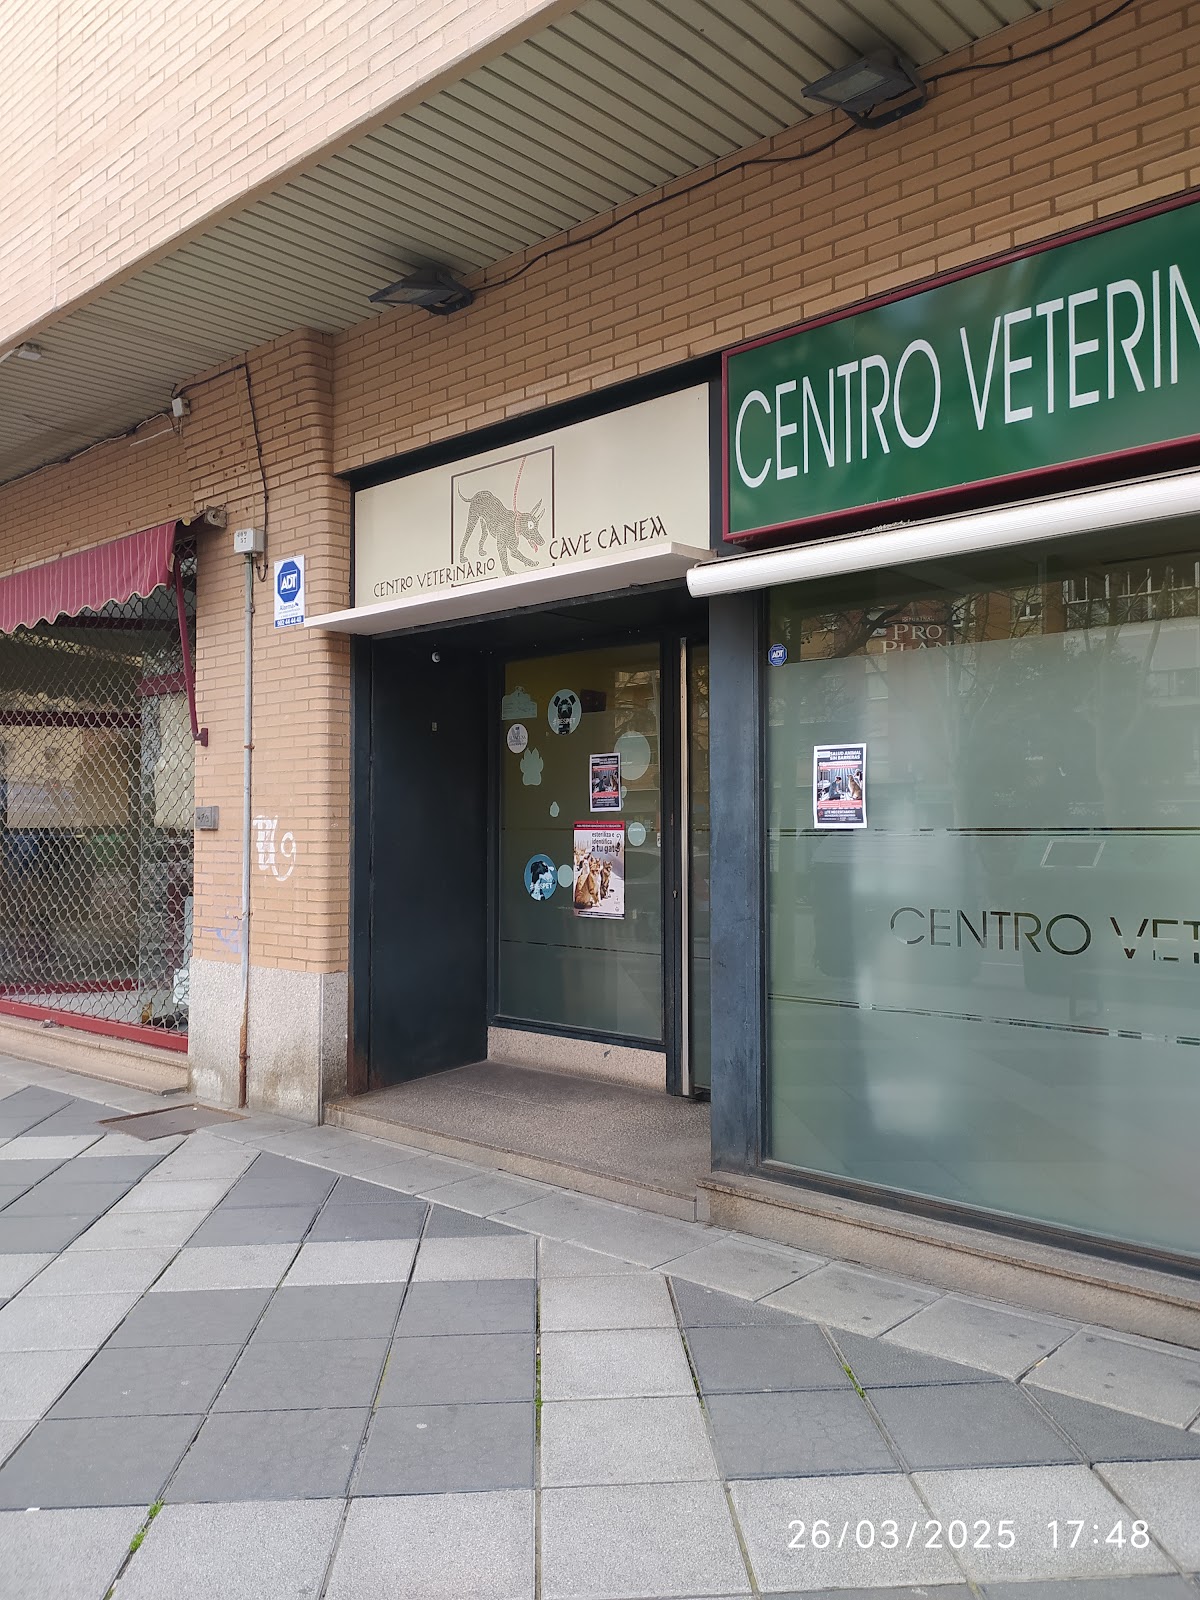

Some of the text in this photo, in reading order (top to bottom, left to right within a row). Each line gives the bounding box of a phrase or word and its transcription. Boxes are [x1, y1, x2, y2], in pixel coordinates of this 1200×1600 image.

[735, 264, 1200, 488] CENTRO VETERIN
[549, 515, 668, 560] CAVE CANEM
[280, 574, 297, 591] ADT
[373, 558, 496, 598] CENTRO VETERINARIO
[892, 623, 943, 641] PRO
[772, 649, 785, 659] ADT
[596, 844, 603, 852] tu
[890, 906, 1092, 956] CENTRO
